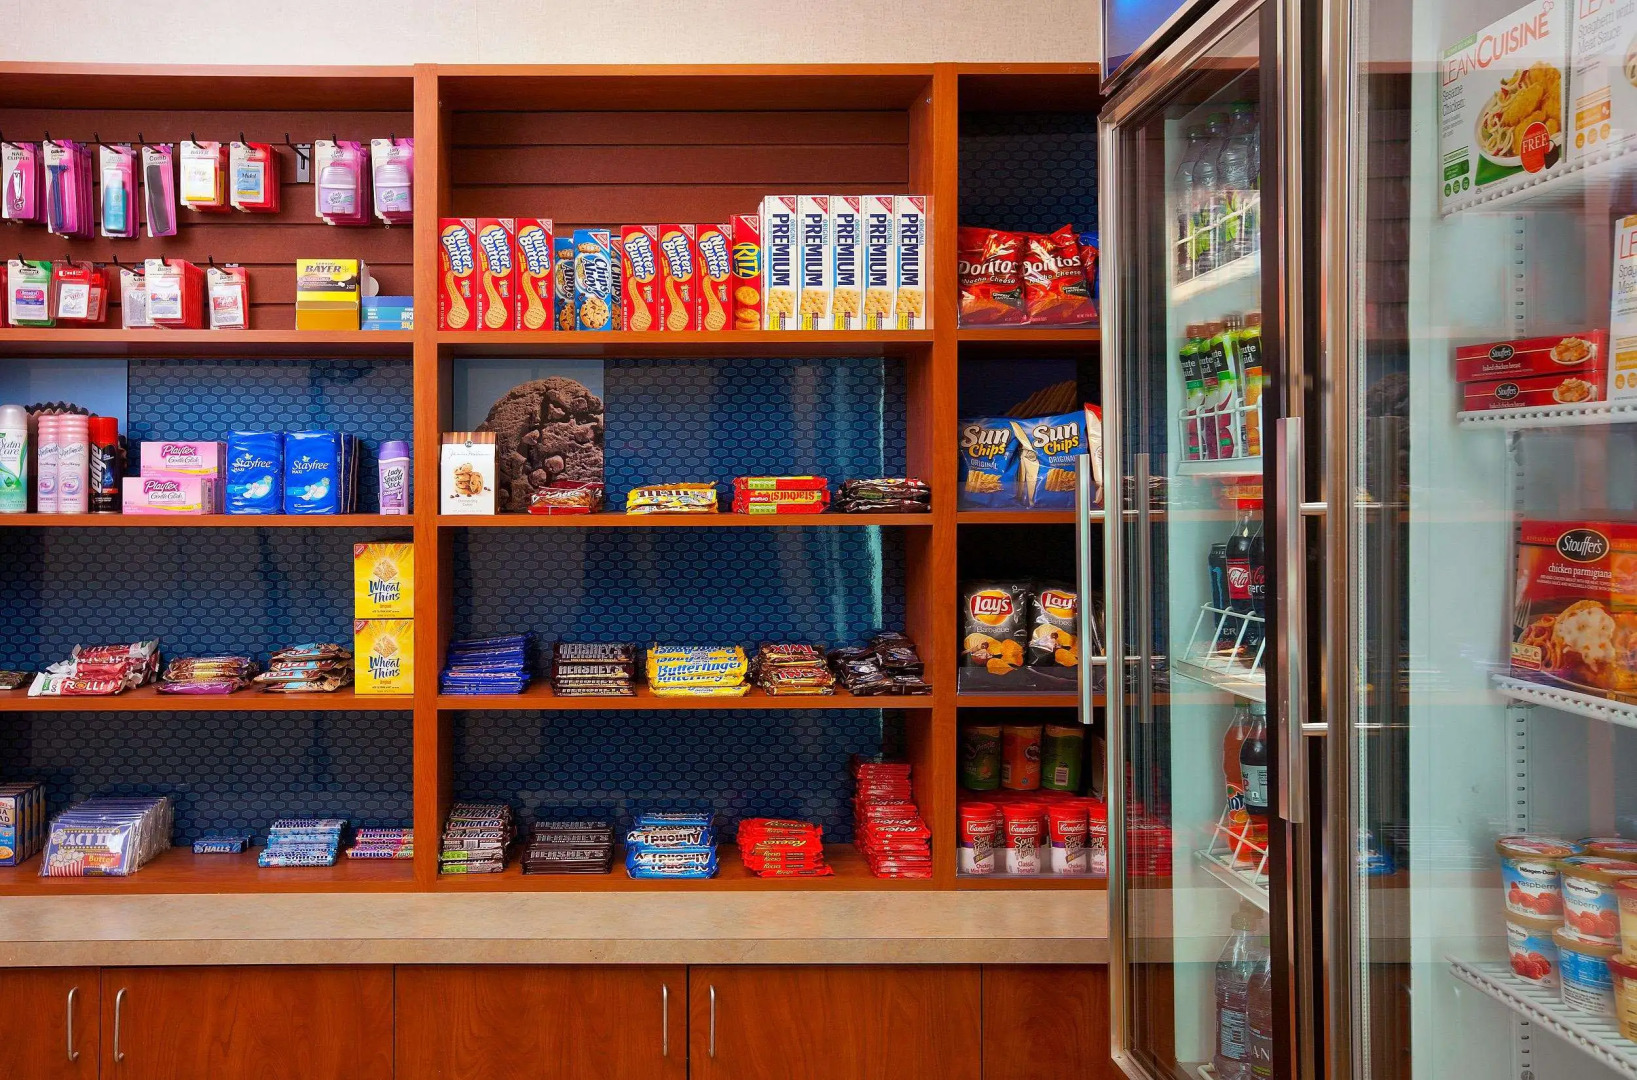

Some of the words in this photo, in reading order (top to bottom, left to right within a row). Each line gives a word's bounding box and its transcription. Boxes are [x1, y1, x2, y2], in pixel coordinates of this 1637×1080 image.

[1442, 47, 1477, 87] LEAN
[1476, 12, 1549, 69] CUISINE
[1522, 132, 1549, 154] FREE
[442, 236, 464, 273] Butter
[452, 228, 473, 270] Nutter
[480, 236, 501, 273] Butter
[490, 228, 512, 270] Nutter
[518, 236, 539, 274] Butter
[529, 229, 550, 271] Nutter
[636, 236, 654, 274] Nutter
[673, 235, 692, 273] Nutter
[711, 235, 730, 274] Nutter
[772, 214, 790, 286] PREMIUM
[805, 214, 822, 286] PREMIUM
[838, 214, 855, 286] PREMIUM
[870, 214, 886, 286] PREMIUM
[902, 214, 918, 286] PREMIUM
[305, 265, 342, 273] BAYER
[625, 242, 645, 280] Butter
[662, 242, 682, 278] Butter
[700, 242, 720, 279] Butter
[733, 245, 759, 277] RITZ
[959, 258, 1018, 276] Doritos
[594, 258, 609, 294] Chips
[989, 275, 1016, 285] Cheese
[1055, 269, 1081, 278] Cheese
[960, 425, 1011, 448] Sun
[1033, 422, 1079, 448] Sun
[162, 444, 196, 458] Playtex
[968, 442, 1006, 460] Chips
[1044, 436, 1079, 455] Chips
[90, 443, 106, 494] edge
[234, 456, 272, 470] Stayfree
[293, 459, 329, 471] Stayfree
[970, 458, 999, 470] ORIGINAL
[1048, 455, 1076, 464] ORIGINA
[384, 473, 404, 482] Speed
[387, 468, 402, 476] Lady
[144, 480, 178, 494] Playtex
[386, 480, 401, 489] Stick
[1562, 535, 1603, 556] Stouffer's
[1230, 568, 1248, 586] Cola
[1548, 562, 1572, 575] chicken
[1572, 566, 1613, 580] parmigiana
[368, 578, 401, 593] Wheat
[368, 592, 401, 604] Thins
[974, 596, 1010, 615] Lay's
[368, 654, 401, 669] Wheat
[658, 662, 742, 678] Butterfinger
[368, 667, 401, 680] Thins
[64, 834, 94, 846] ACT
[650, 831, 702, 844] Almond
[1014, 836, 1035, 846] Soup
[202, 845, 231, 854] HALLS
[88, 855, 115, 864] Butter
[1518, 880, 1558, 891] raspberry
